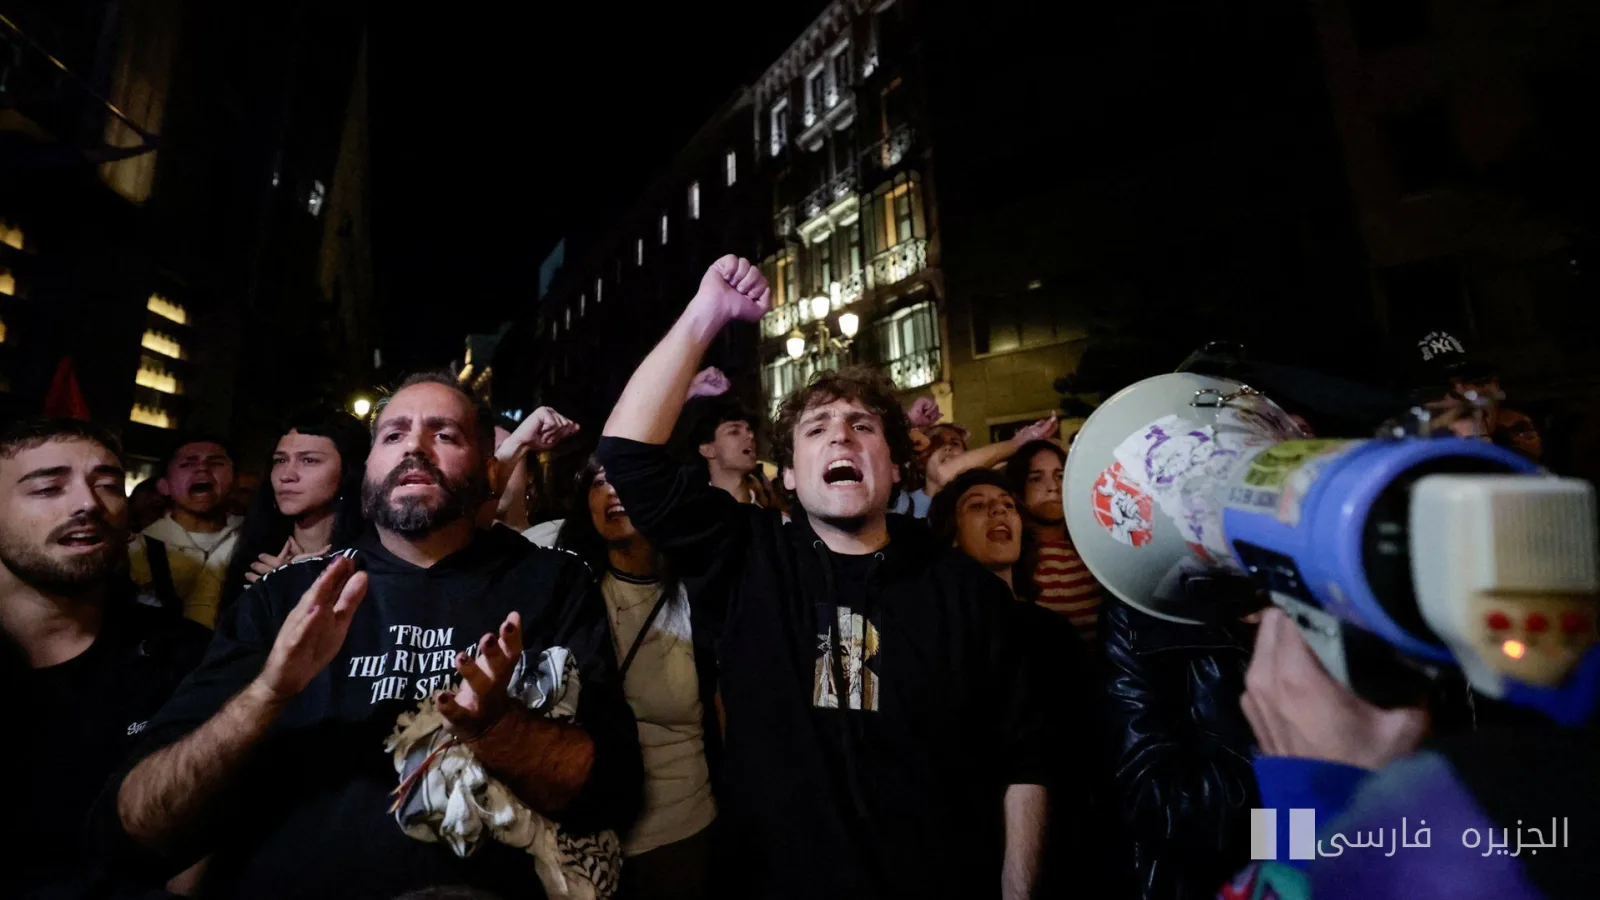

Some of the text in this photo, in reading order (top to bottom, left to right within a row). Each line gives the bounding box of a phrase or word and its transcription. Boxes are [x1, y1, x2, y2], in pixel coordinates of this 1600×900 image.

[348, 652, 389, 678] THE
[393, 649, 456, 674] RIVER
[370, 676, 408, 704] THE
